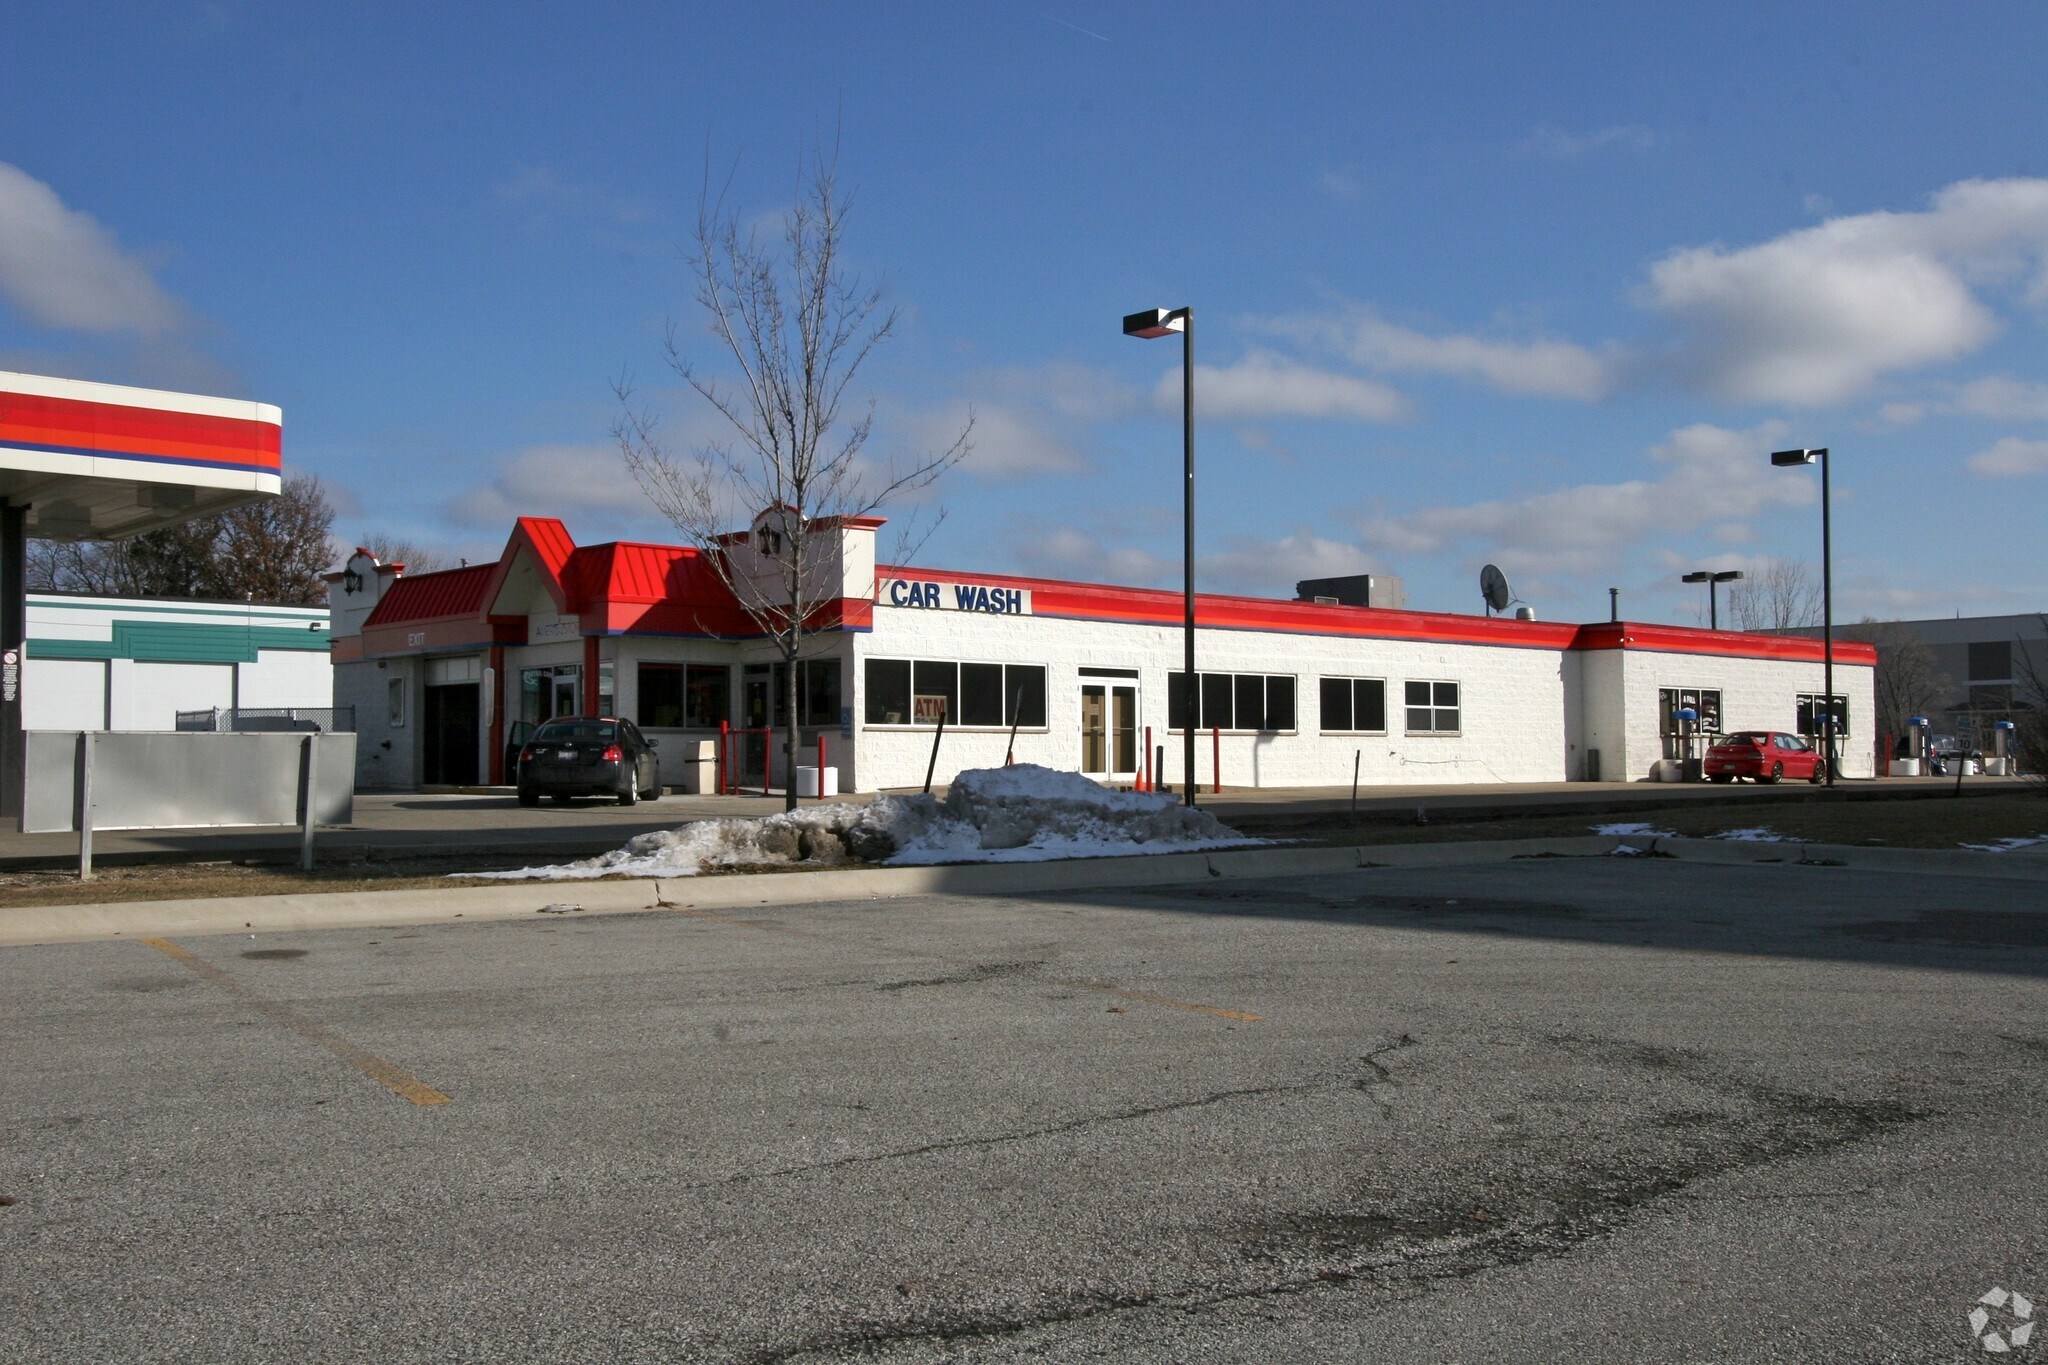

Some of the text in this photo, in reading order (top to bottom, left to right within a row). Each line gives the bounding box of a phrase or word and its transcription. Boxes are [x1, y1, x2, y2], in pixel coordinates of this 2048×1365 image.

[890, 580, 1022, 614] CAR WASH
[408, 632, 425, 646] EXIT
[915, 698, 945, 717] ATM
[1959, 739, 1971, 749] 10
